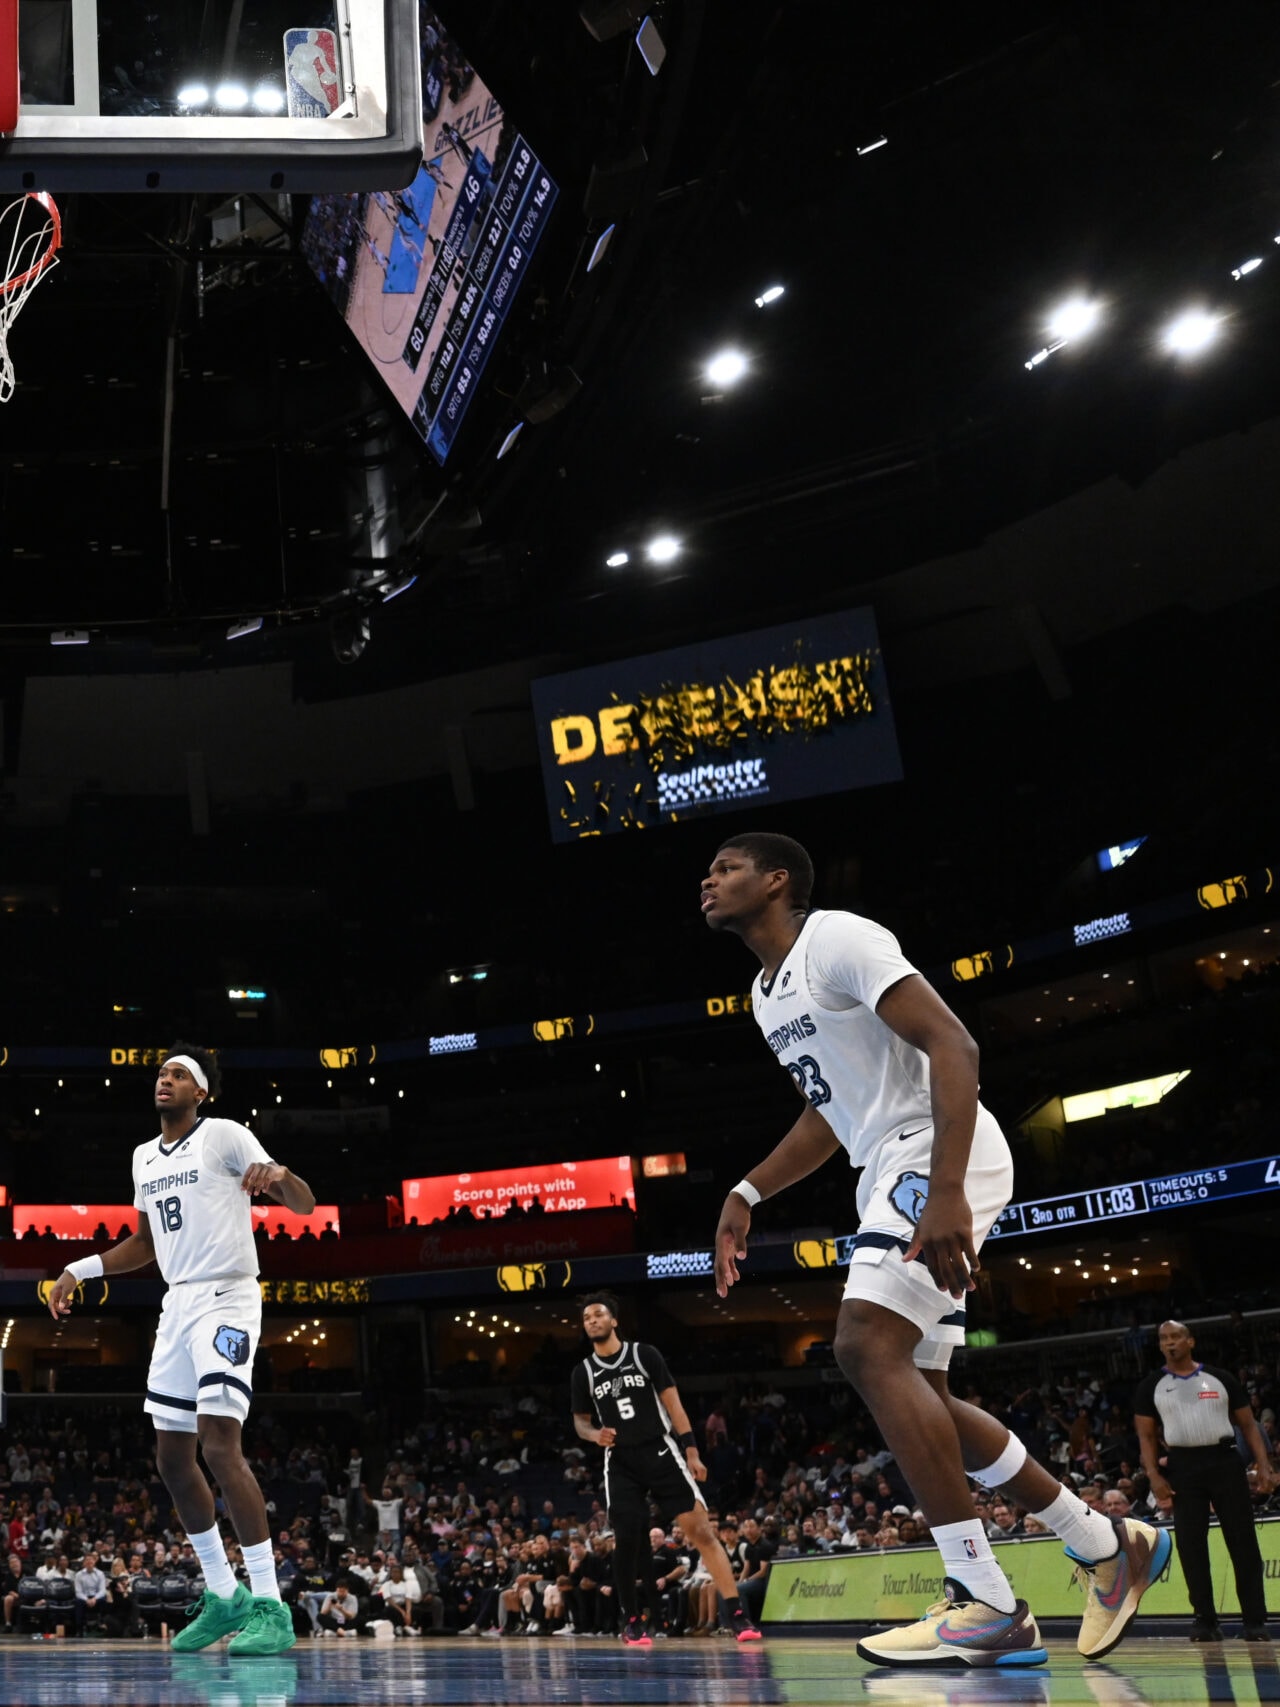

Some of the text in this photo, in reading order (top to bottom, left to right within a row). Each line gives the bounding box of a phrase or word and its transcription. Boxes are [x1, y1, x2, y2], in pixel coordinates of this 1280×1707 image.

[297, 103, 322, 118] NBA
[465, 175, 480, 204] 46
[430, 149, 531, 395] ORTG 112.9 TS% 59.8% OREB% 22.7 TOV% 13.8
[447, 177, 551, 420] ORTG 85.9 TS% 50.5% OREB% 0.0 TOV% 14.9
[410, 327, 425, 352] 60
[657, 758, 763, 791] SealMaster
[1073, 912, 1129, 936] SealMaster
[429, 1032, 476, 1046] SealMaster
[767, 1013, 816, 1055] EMPHIS
[141, 1169, 199, 1198] MEMPHIS
[453, 1177, 575, 1202] Score points with
[1149, 1170, 1228, 1194] TIMEOUTS: 5
[558, 1197, 586, 1211] App
[1031, 1186, 1136, 1224] 3RD QTR 11:03
[1152, 1186, 1209, 1207] FOULS: 0
[155, 1195, 183, 1234] 18
[1009, 1208, 1017, 1219] 5
[647, 1252, 711, 1266] SealMaster
[594, 1374, 645, 1399] SPURS
[616, 1396, 635, 1420] 5
[799, 1572, 944, 1599] Robinhood Your Money
